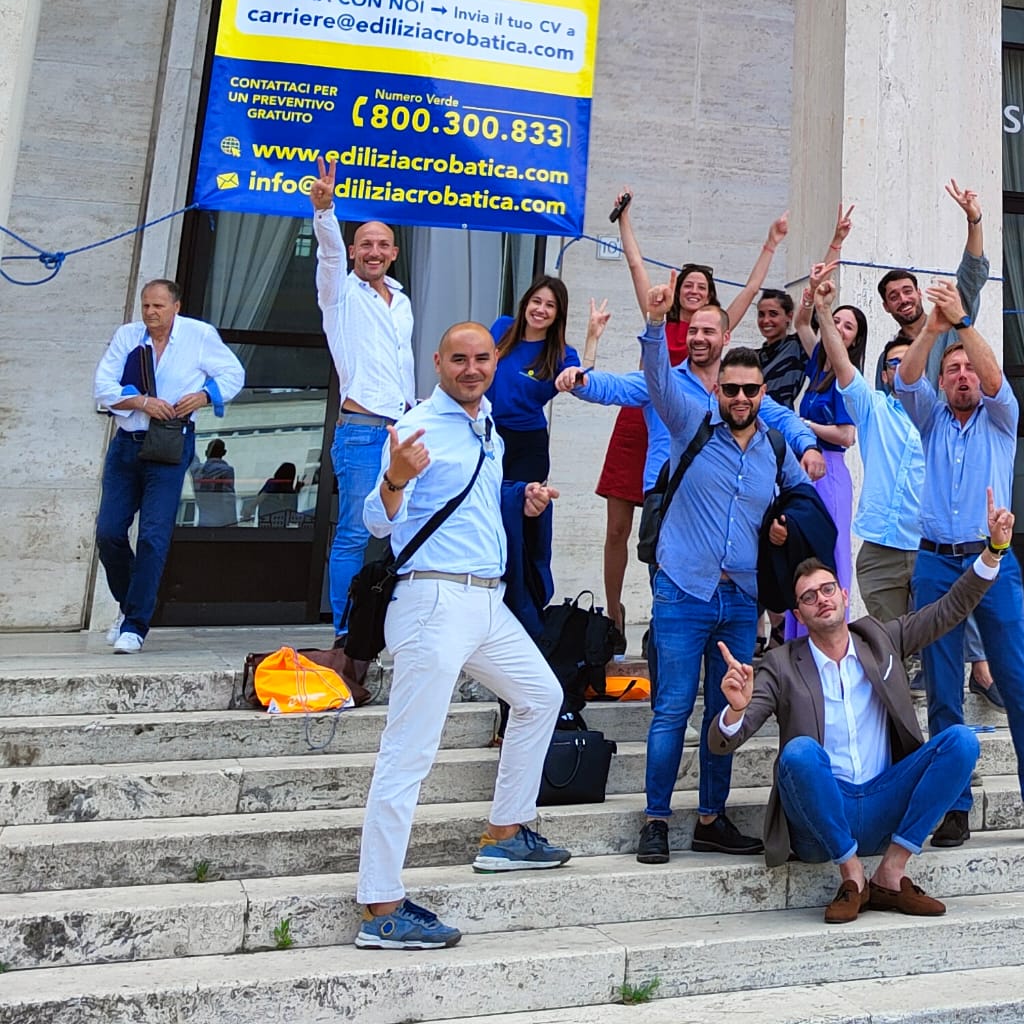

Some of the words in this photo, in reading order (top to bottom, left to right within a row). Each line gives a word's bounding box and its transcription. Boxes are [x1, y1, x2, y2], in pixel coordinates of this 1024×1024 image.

[247, 8, 574, 61] carriere@ediliziacrobatica.com
[454, 6, 490, 24] Invia
[494, 12, 503, 26] il
[507, 16, 533, 30] tuo
[539, 19, 562, 34] CV
[566, 27, 576, 37] a
[229, 76, 310, 94] CONTATTACI
[313, 84, 338, 97] PER
[374, 88, 423, 103] Numero
[425, 94, 460, 107] Verde
[228, 91, 249, 104] UN
[252, 94, 335, 111] PREVENTIVO
[247, 108, 313, 123] GRATUITO
[370, 104, 563, 148] 800.300.833
[252, 143, 569, 185] wwwediliziacrobatica.com
